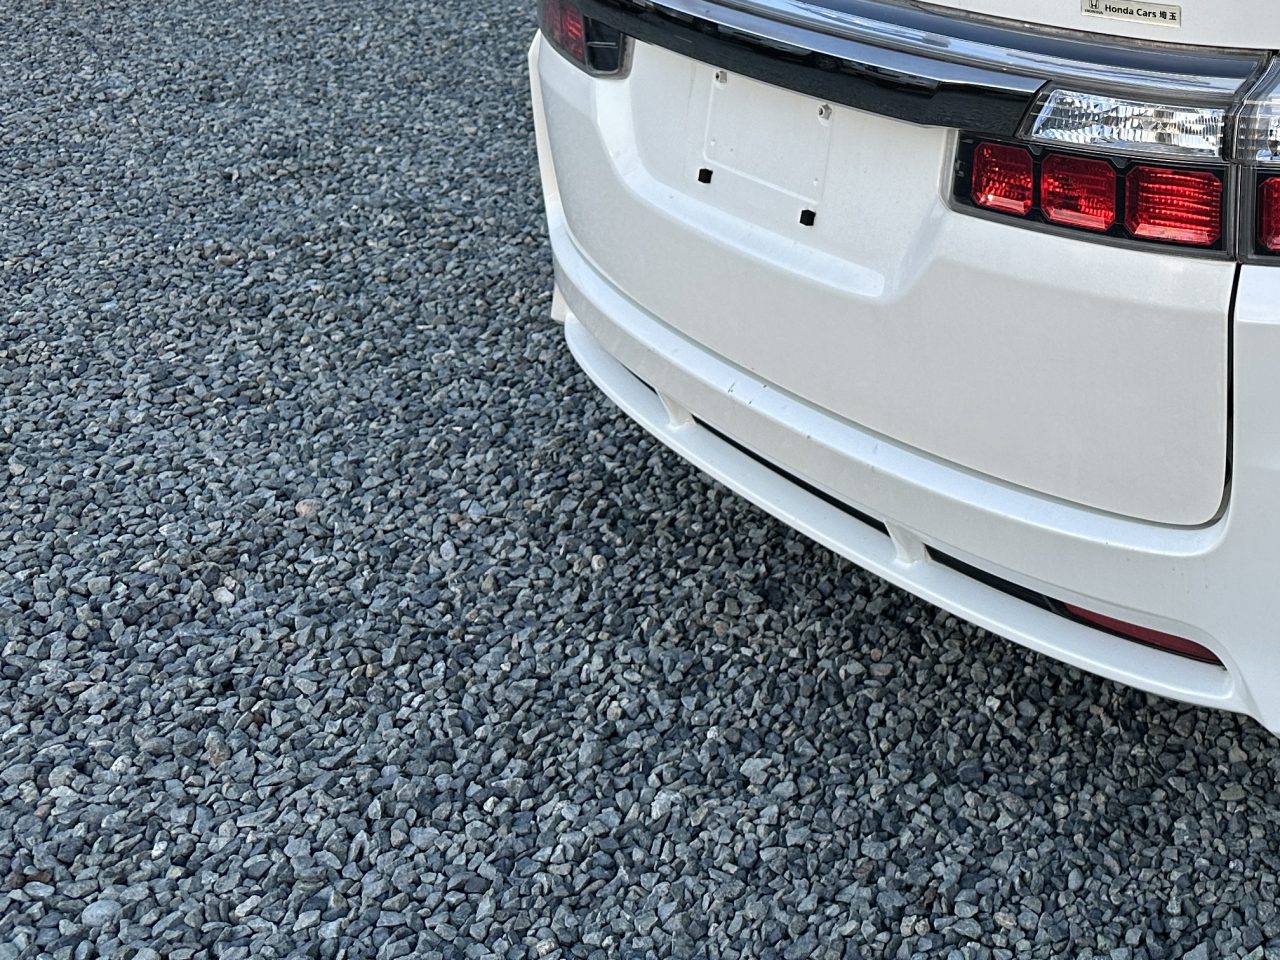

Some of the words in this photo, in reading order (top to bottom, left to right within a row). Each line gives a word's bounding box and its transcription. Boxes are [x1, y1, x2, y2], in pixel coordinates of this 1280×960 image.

[1105, 4, 1134, 16] Honda
[1136, 8, 1157, 18] Cars
[1160, 10, 1177, 21] 埼玉
